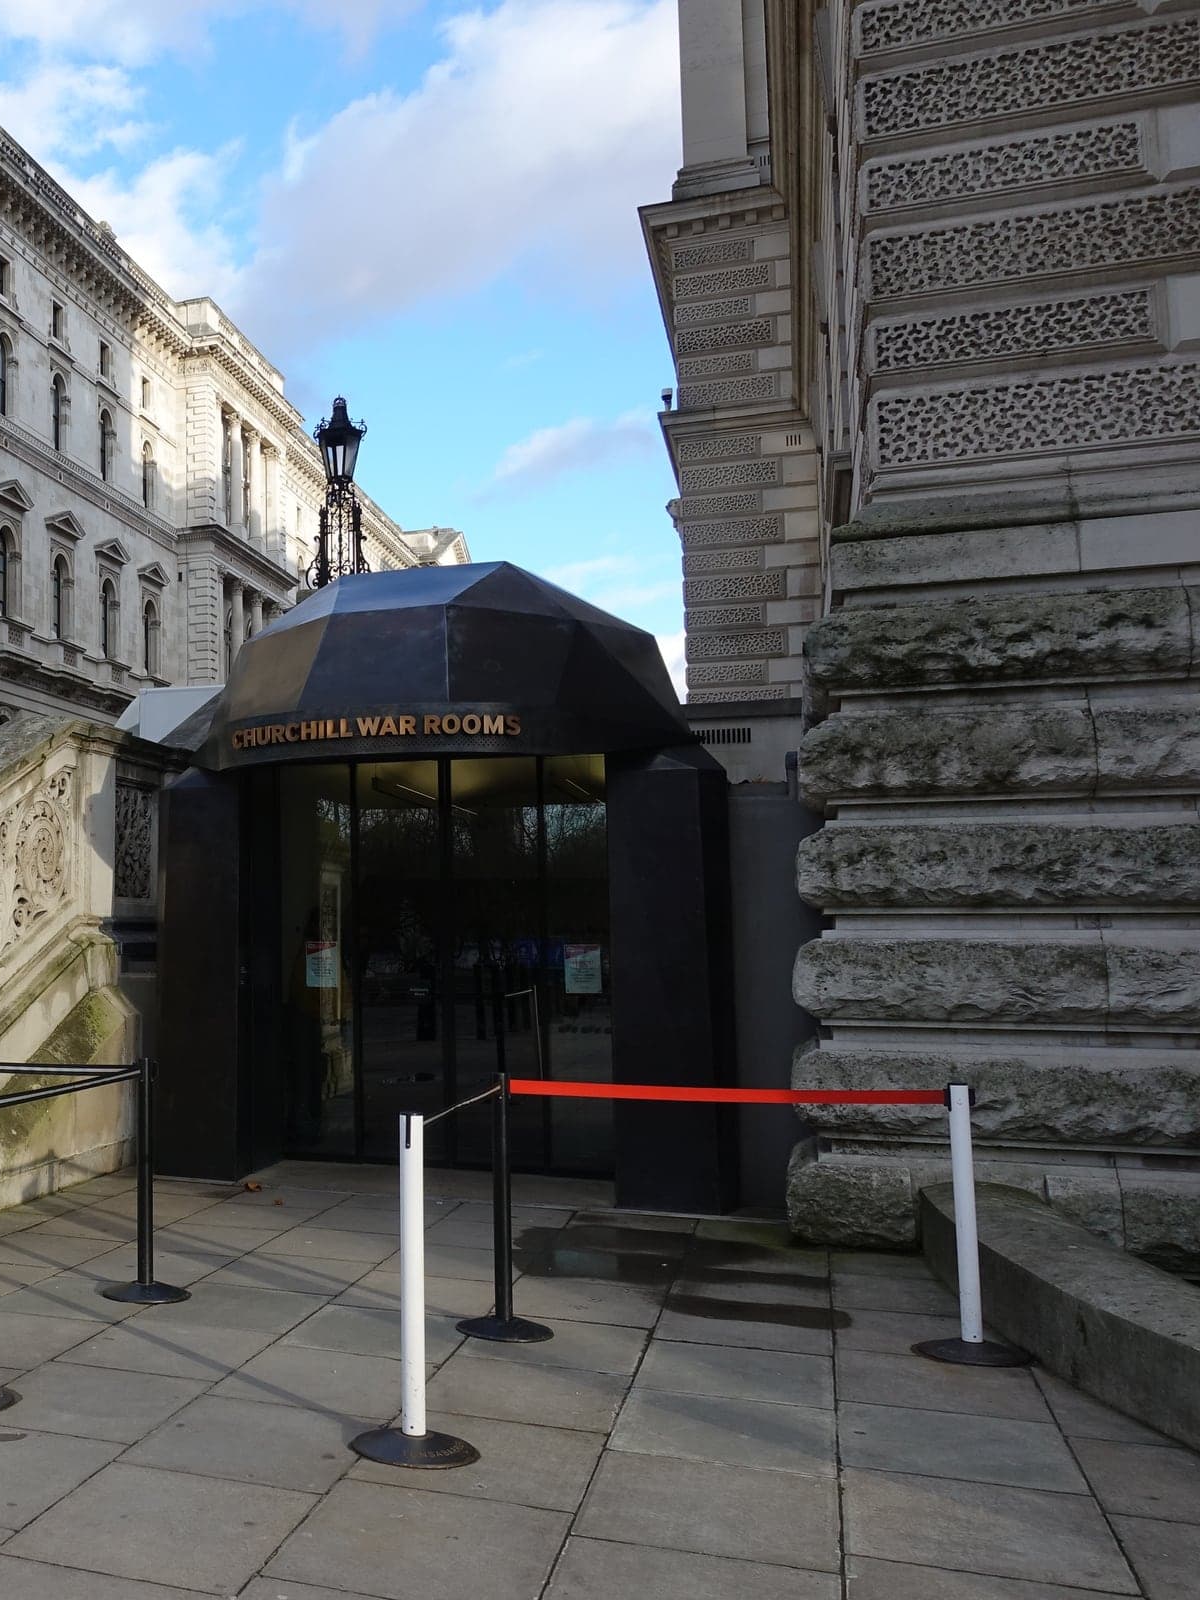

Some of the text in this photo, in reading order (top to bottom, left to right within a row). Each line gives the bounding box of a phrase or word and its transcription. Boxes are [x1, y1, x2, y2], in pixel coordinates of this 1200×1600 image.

[232, 714, 521, 750] CHURCHILL WAR ROOMS
